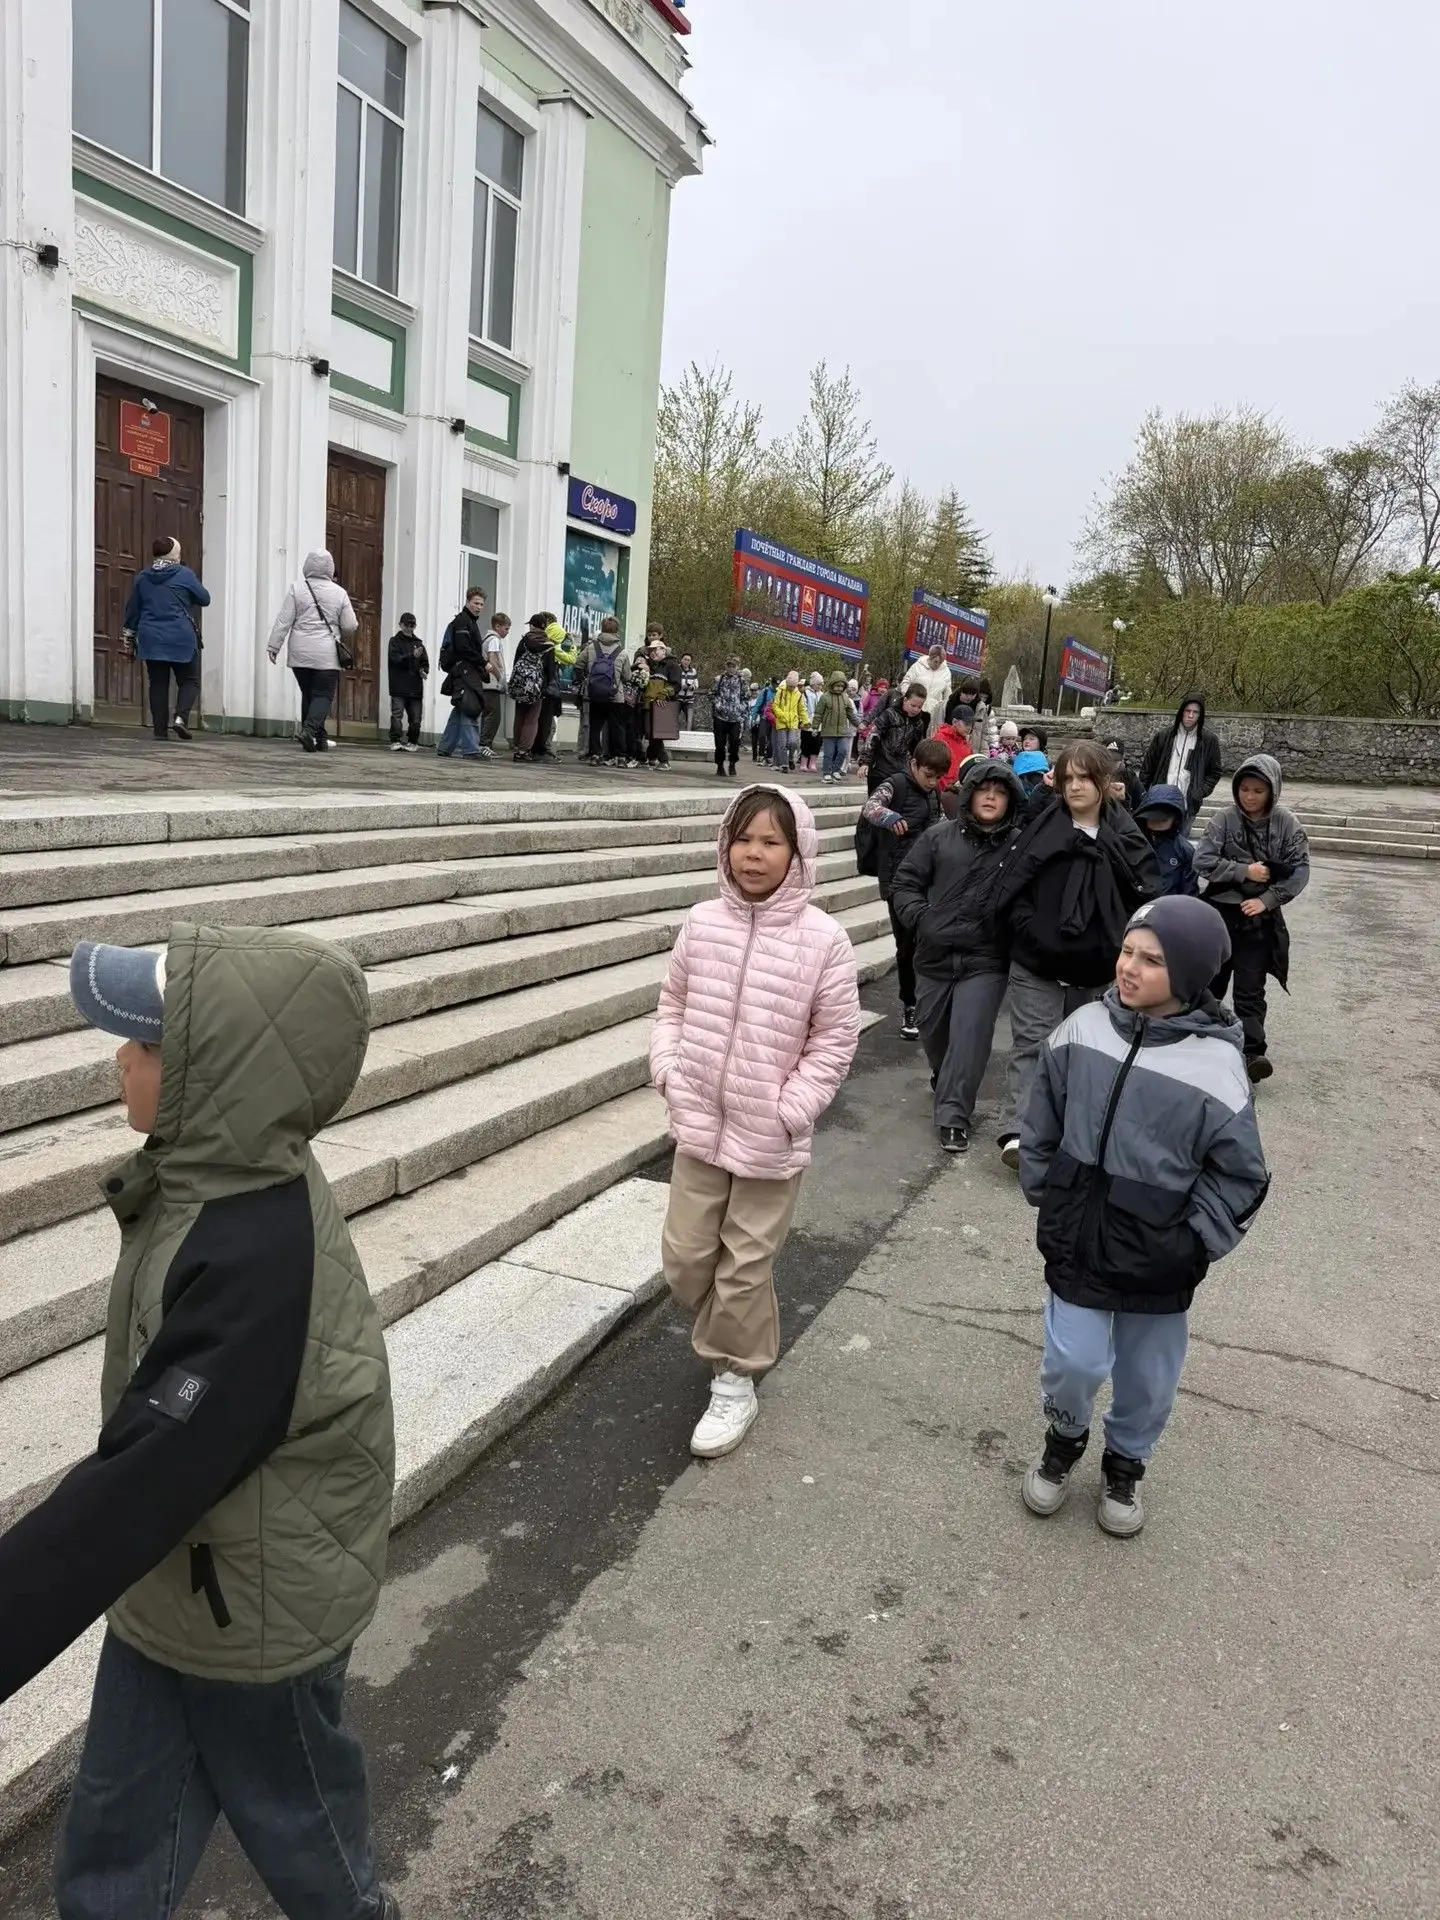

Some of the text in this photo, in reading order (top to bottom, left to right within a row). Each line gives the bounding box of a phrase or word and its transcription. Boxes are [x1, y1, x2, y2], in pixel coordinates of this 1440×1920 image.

[581, 484, 618, 524] Скоро
[786, 553, 816, 574] ГРАЖДАНЕ
[817, 566, 837, 582] ГОРОДА
[178, 1378, 199, 1401] R
